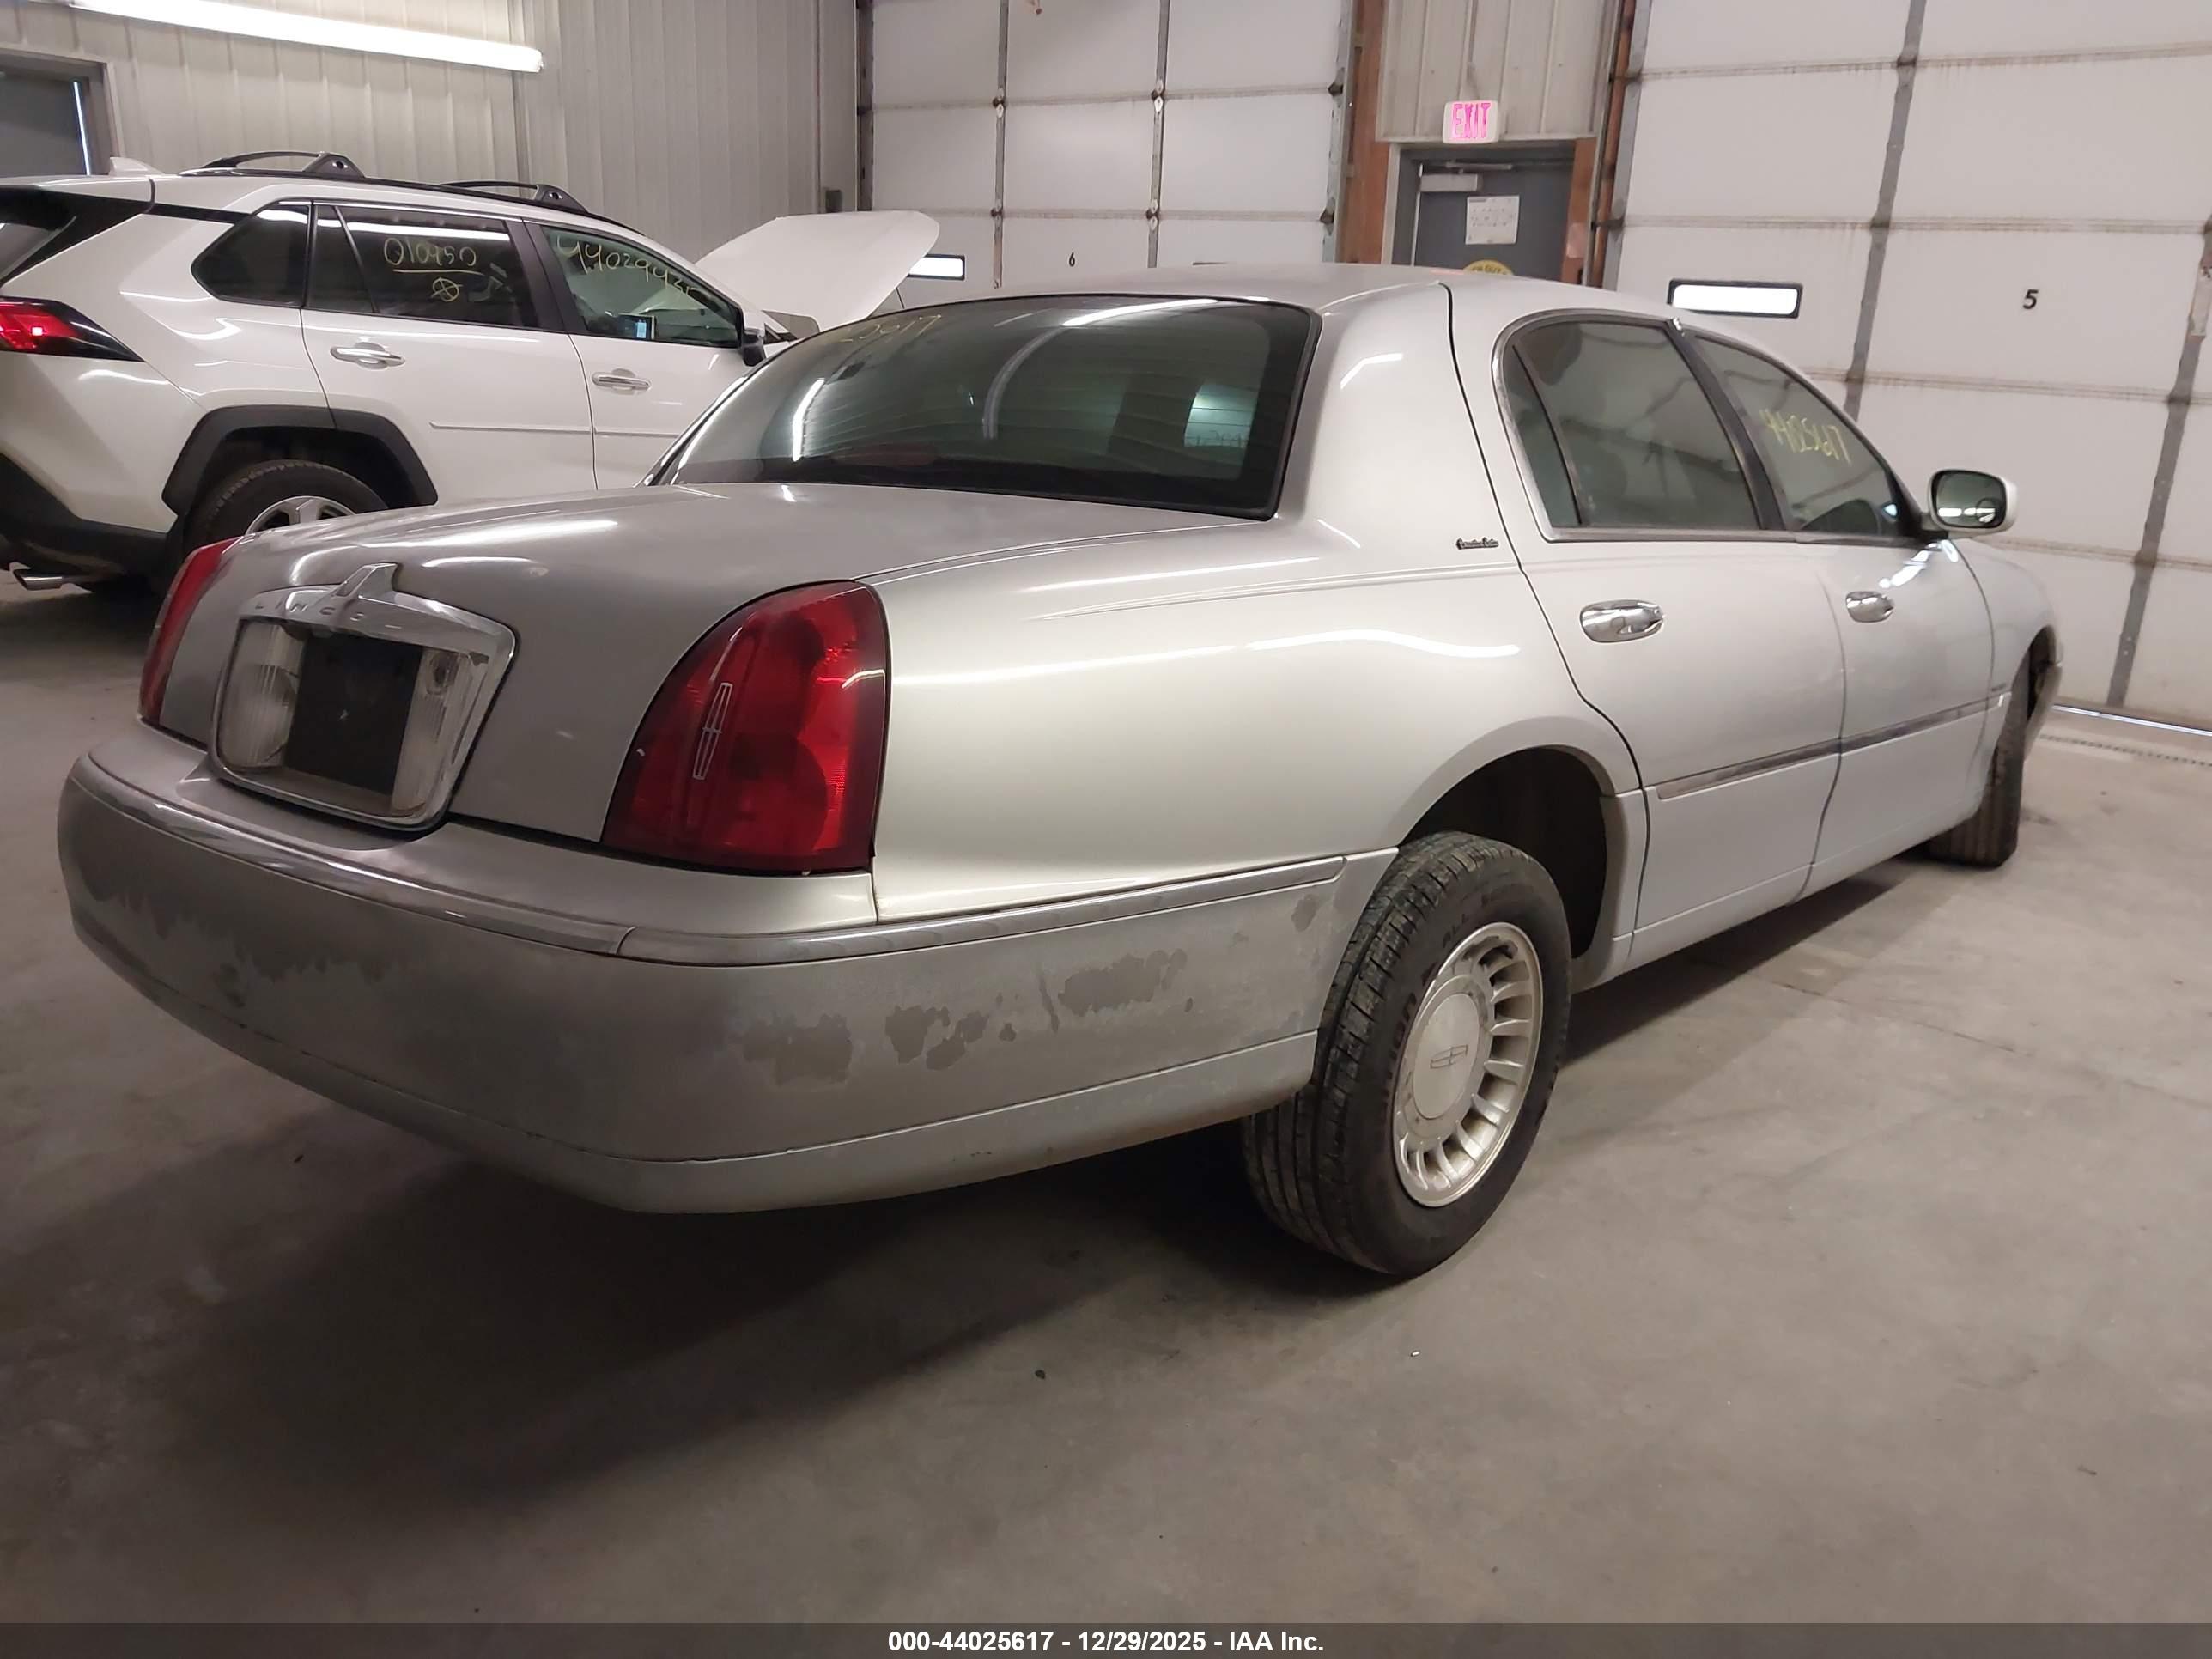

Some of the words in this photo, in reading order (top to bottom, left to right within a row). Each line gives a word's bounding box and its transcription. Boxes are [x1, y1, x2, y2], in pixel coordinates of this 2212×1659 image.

[1452, 102, 1492, 138] EXIT
[1068, 252, 1076, 267] 6
[2022, 288, 2039, 310] 5
